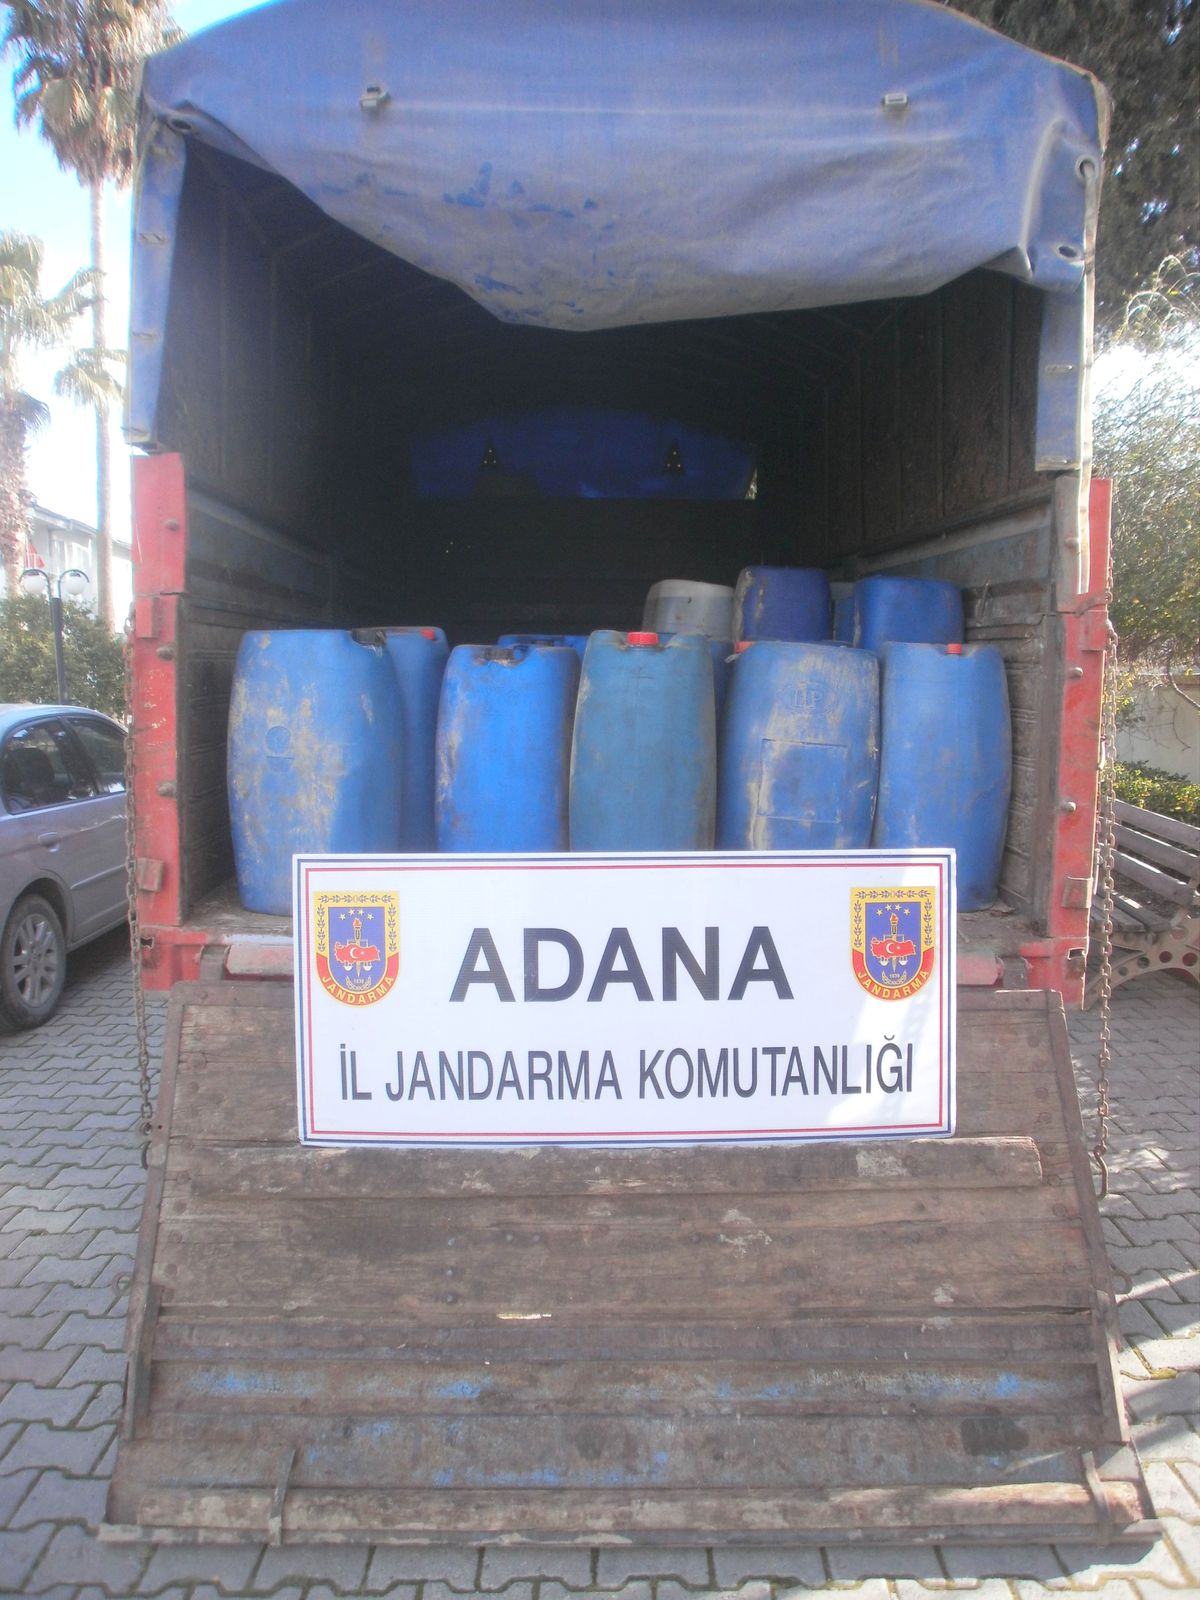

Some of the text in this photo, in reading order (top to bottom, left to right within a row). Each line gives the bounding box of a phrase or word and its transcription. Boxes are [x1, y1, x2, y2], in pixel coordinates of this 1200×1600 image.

[449, 925, 795, 1003] ADANA
[857, 970, 929, 999] JANDARMA
[322, 976, 395, 1004] JANDARMA
[340, 1034, 913, 1102] İL JANDARMA KOMUTANLIĞI
